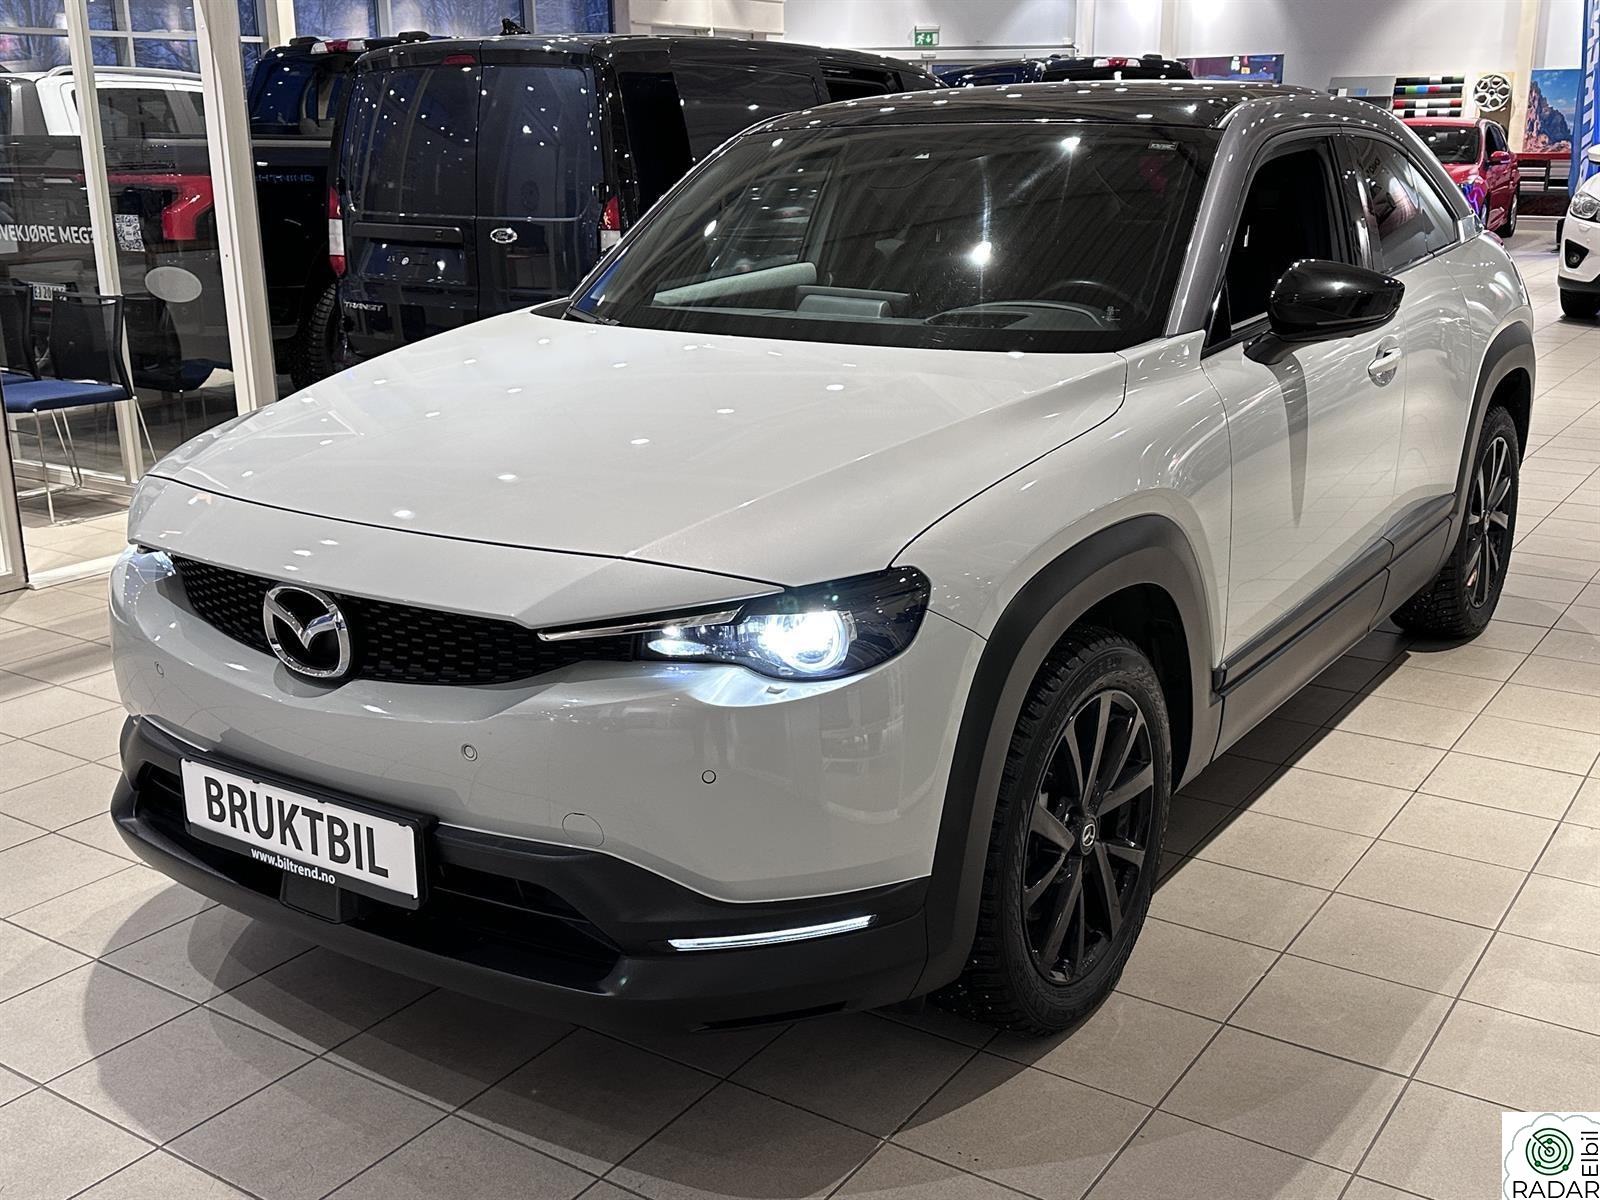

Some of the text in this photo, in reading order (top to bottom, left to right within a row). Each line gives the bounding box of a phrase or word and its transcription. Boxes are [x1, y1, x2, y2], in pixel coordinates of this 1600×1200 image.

[0, 224, 57, 243] VEKJØRE
[204, 776, 389, 879] BRUKTBIL
[250, 848, 336, 884] www.biltrend.no
